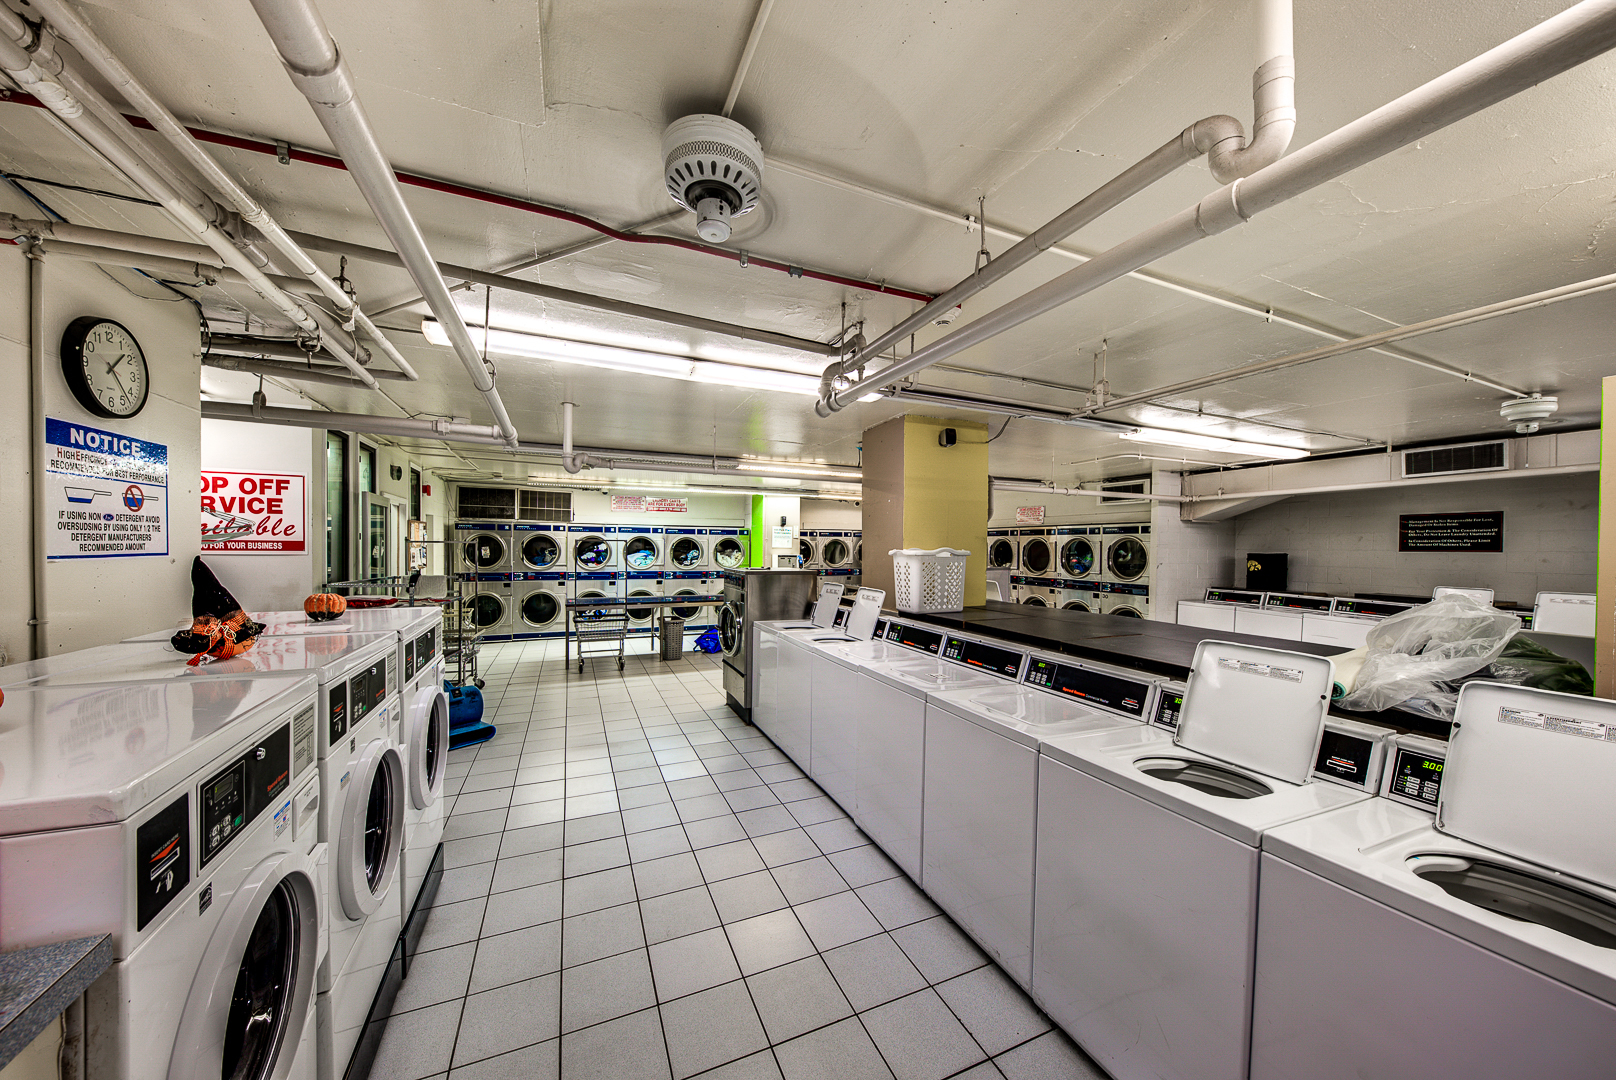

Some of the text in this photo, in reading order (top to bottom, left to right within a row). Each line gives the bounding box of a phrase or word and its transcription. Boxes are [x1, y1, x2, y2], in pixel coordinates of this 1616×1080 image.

[93, 332, 101, 343] 11
[104, 330, 113, 344] 12
[119, 340, 123, 350] 1
[83, 355, 88, 367] 9
[127, 354, 132, 365] 2
[130, 372, 136, 382] 3
[97, 388, 103, 400] 7
[128, 387, 133, 397] 4
[108, 396, 115, 408] 6
[120, 395, 126, 406] 5
[70, 428, 140, 456] NOTICE
[239, 478, 290, 495] OFF
[58, 511, 65, 519] IF
[67, 511, 87, 520] USING
[116, 514, 144, 522] DETERGENT
[58, 522, 102, 531] OVERSUDSING
[113, 524, 128, 532] USING
[71, 533, 152, 541] DETERGENT MANUFACTURERS
[80, 543, 124, 552] RECOMMENDED
[1423, 761, 1443, 771] 3.00
